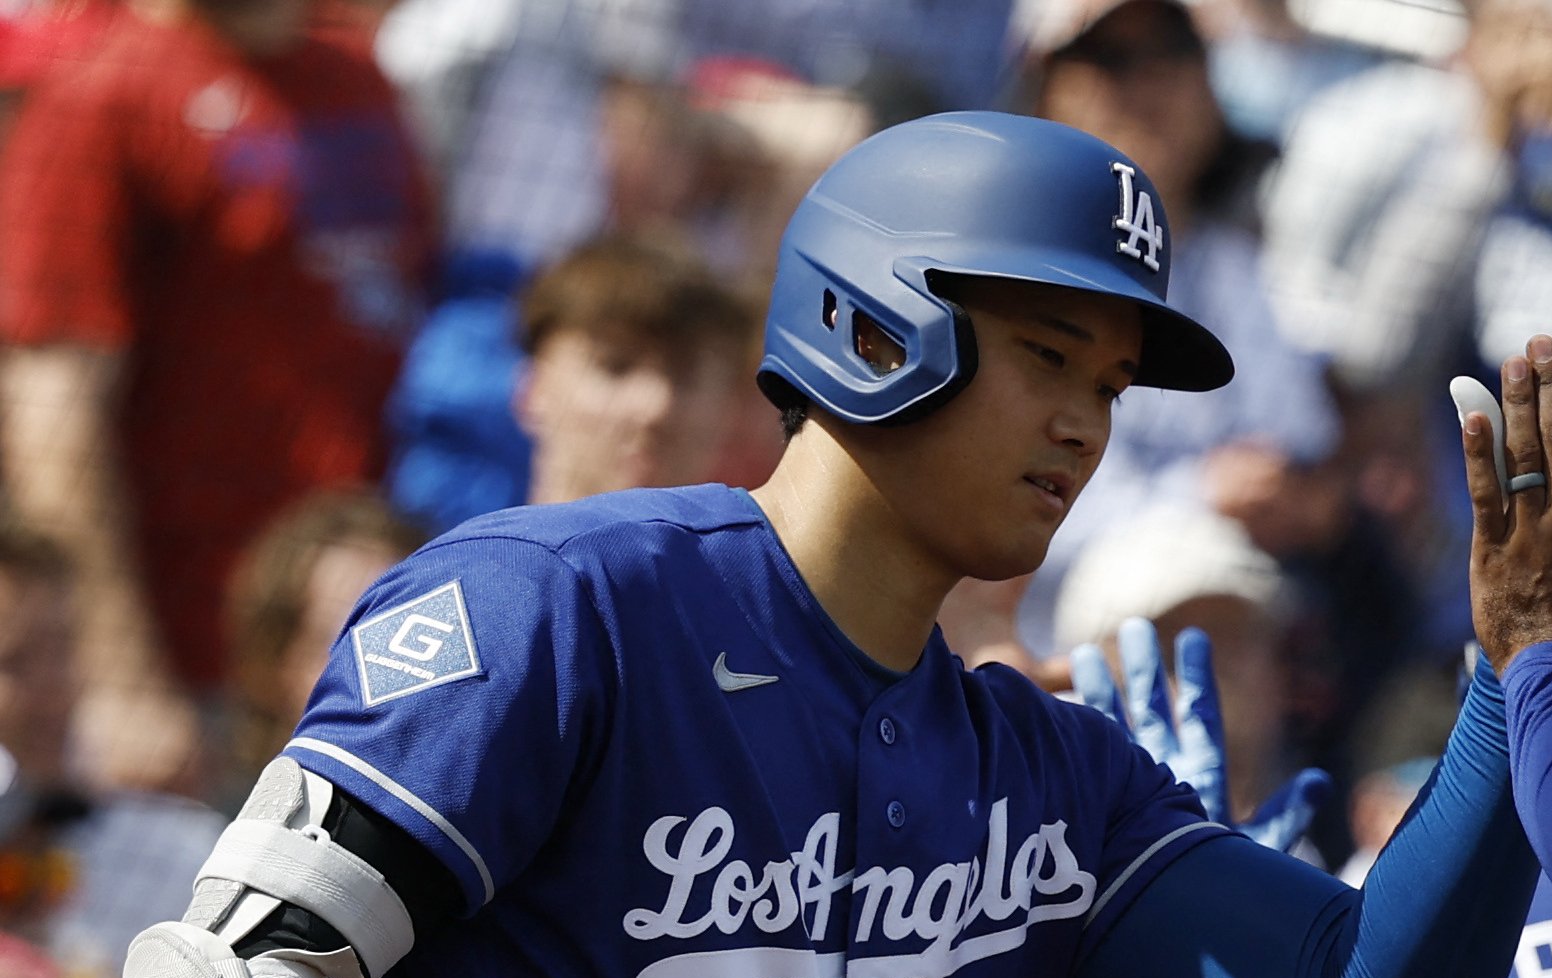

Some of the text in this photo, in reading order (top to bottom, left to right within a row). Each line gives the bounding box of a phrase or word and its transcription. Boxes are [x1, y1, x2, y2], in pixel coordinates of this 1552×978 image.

[1108, 161, 1163, 272] LA
[388, 613, 454, 662] G
[623, 806, 799, 941] Los
